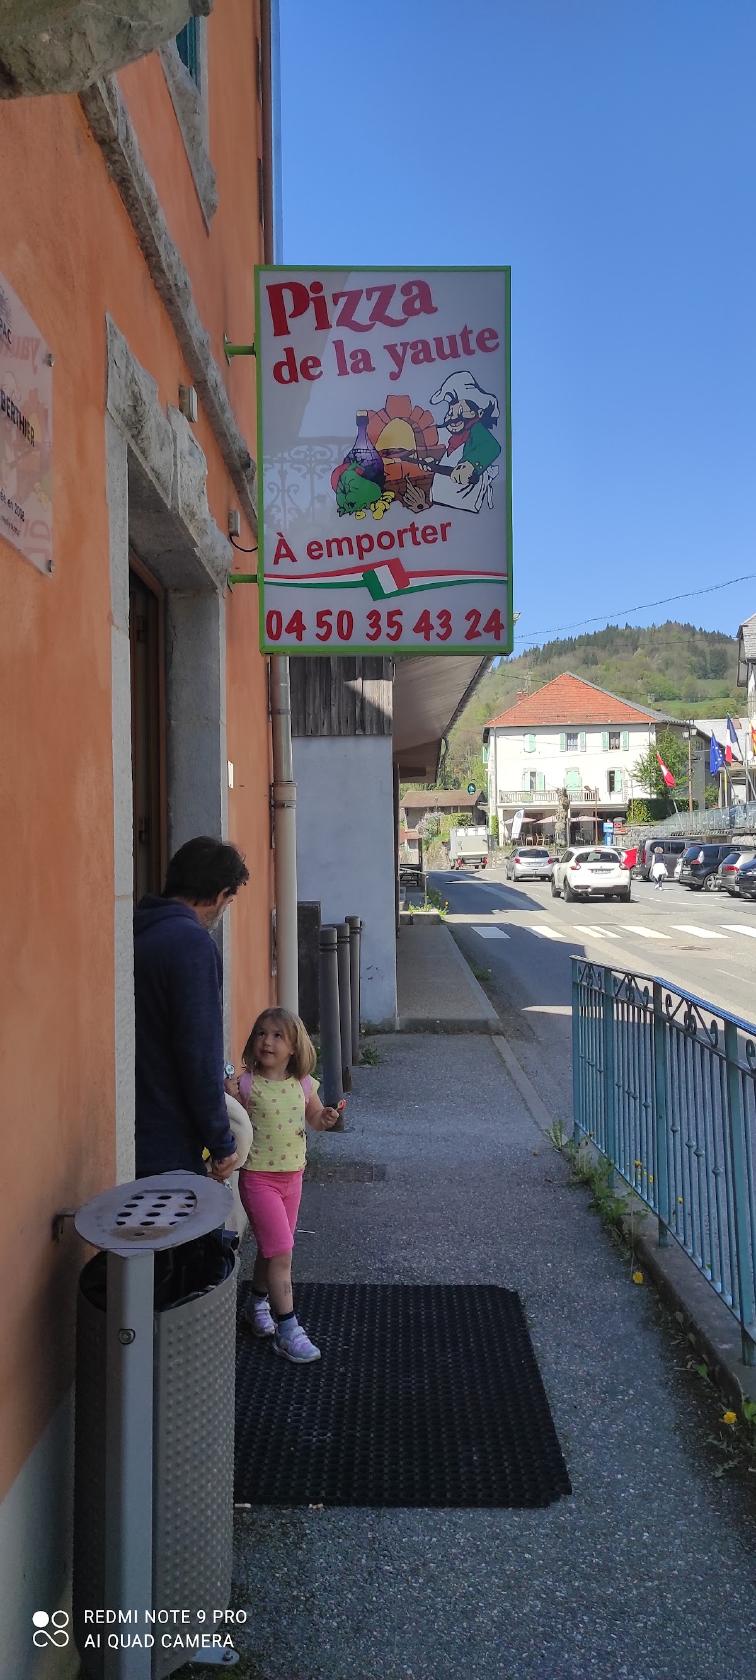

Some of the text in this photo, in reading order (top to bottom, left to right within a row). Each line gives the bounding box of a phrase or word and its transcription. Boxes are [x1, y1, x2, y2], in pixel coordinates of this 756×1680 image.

[266, 279, 438, 337] Pizza
[273, 324, 501, 385] de la yaute
[0, 389, 35, 448] BERTHIER
[273, 519, 452, 565] À emporter
[265, 608, 504, 641] 04 50 35 43 24
